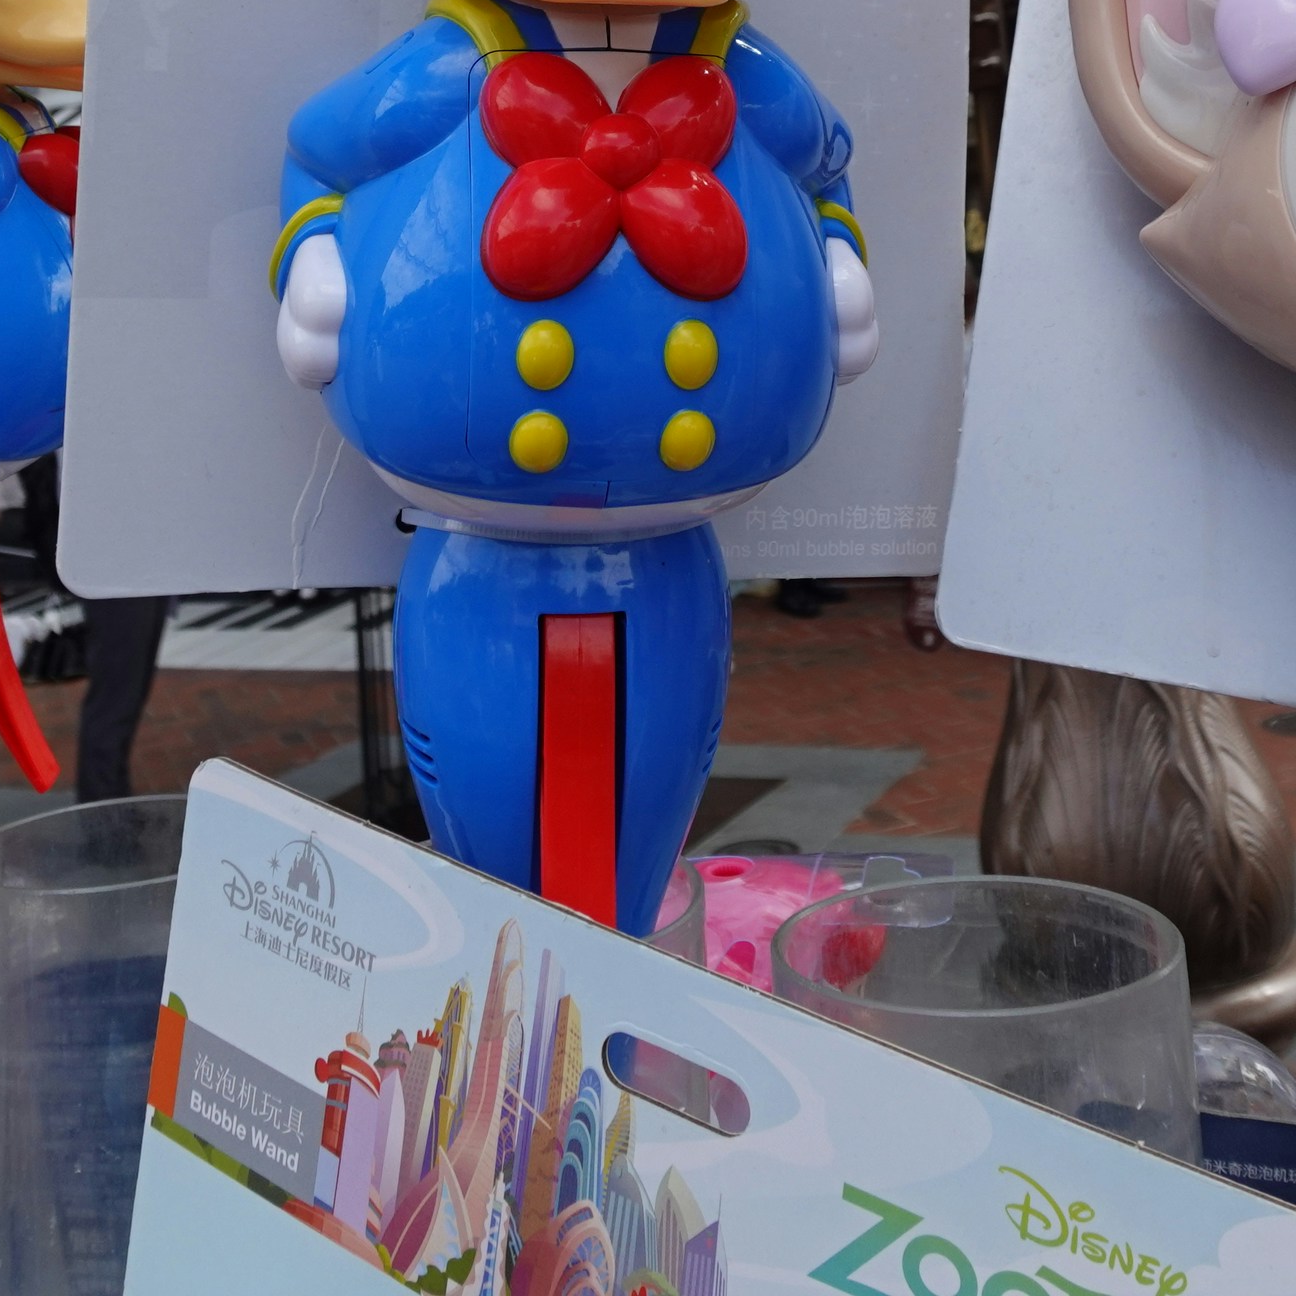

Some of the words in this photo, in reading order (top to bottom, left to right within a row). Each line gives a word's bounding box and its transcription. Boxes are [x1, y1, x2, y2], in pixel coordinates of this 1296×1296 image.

[745, 504, 939, 530] 内含90ml泡泡溶液
[807, 540, 865, 557] bubble
[871, 539, 938, 556] solution
[272, 884, 337, 929] SHANGHAI
[240, 920, 352, 991] 上海迪士尼度假区
[311, 924, 377, 973] RESORT
[194, 1051, 304, 1144] 泡泡机玩具
[190, 1089, 247, 1141] Bubble
[251, 1125, 300, 1174] Wand
